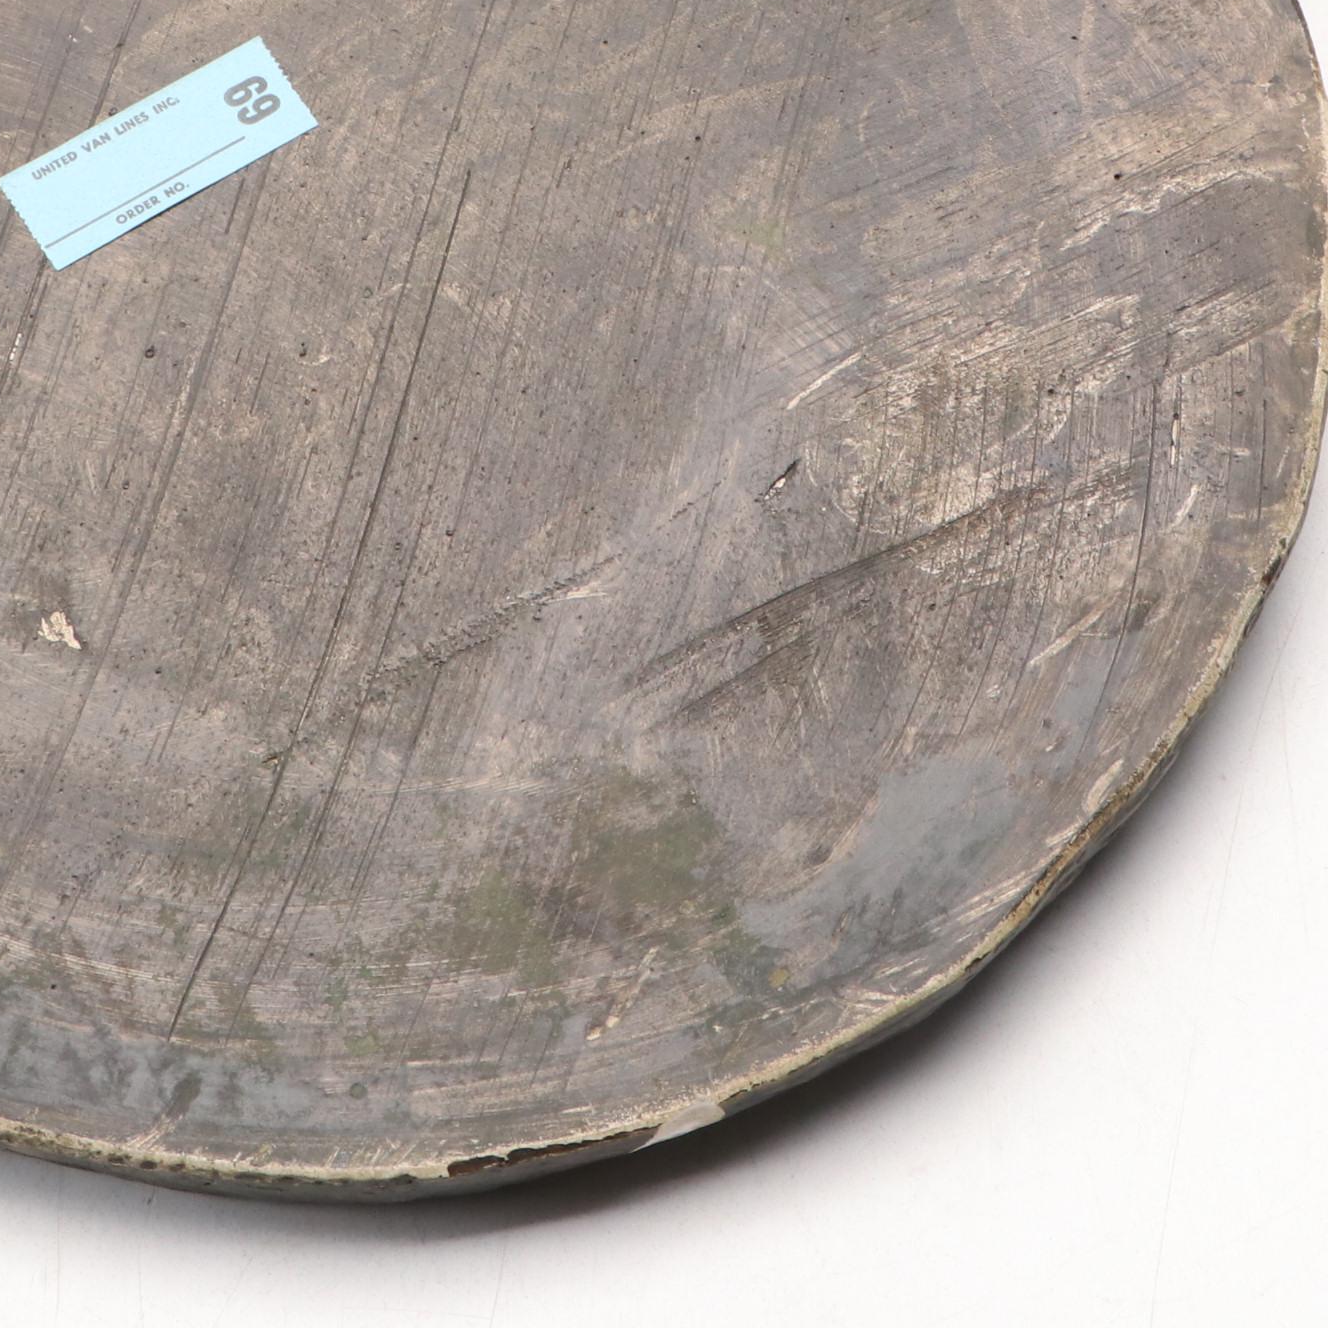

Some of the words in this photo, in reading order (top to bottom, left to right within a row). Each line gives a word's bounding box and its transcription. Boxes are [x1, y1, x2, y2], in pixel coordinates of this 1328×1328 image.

[223, 75, 281, 125] 69
[31, 151, 78, 180] UNITED
[80, 132, 111, 153] VAN
[113, 111, 150, 136] LINES
[152, 96, 181, 115] INC.
[115, 195, 161, 225] ORDER
[163, 181, 190, 199] NO.
